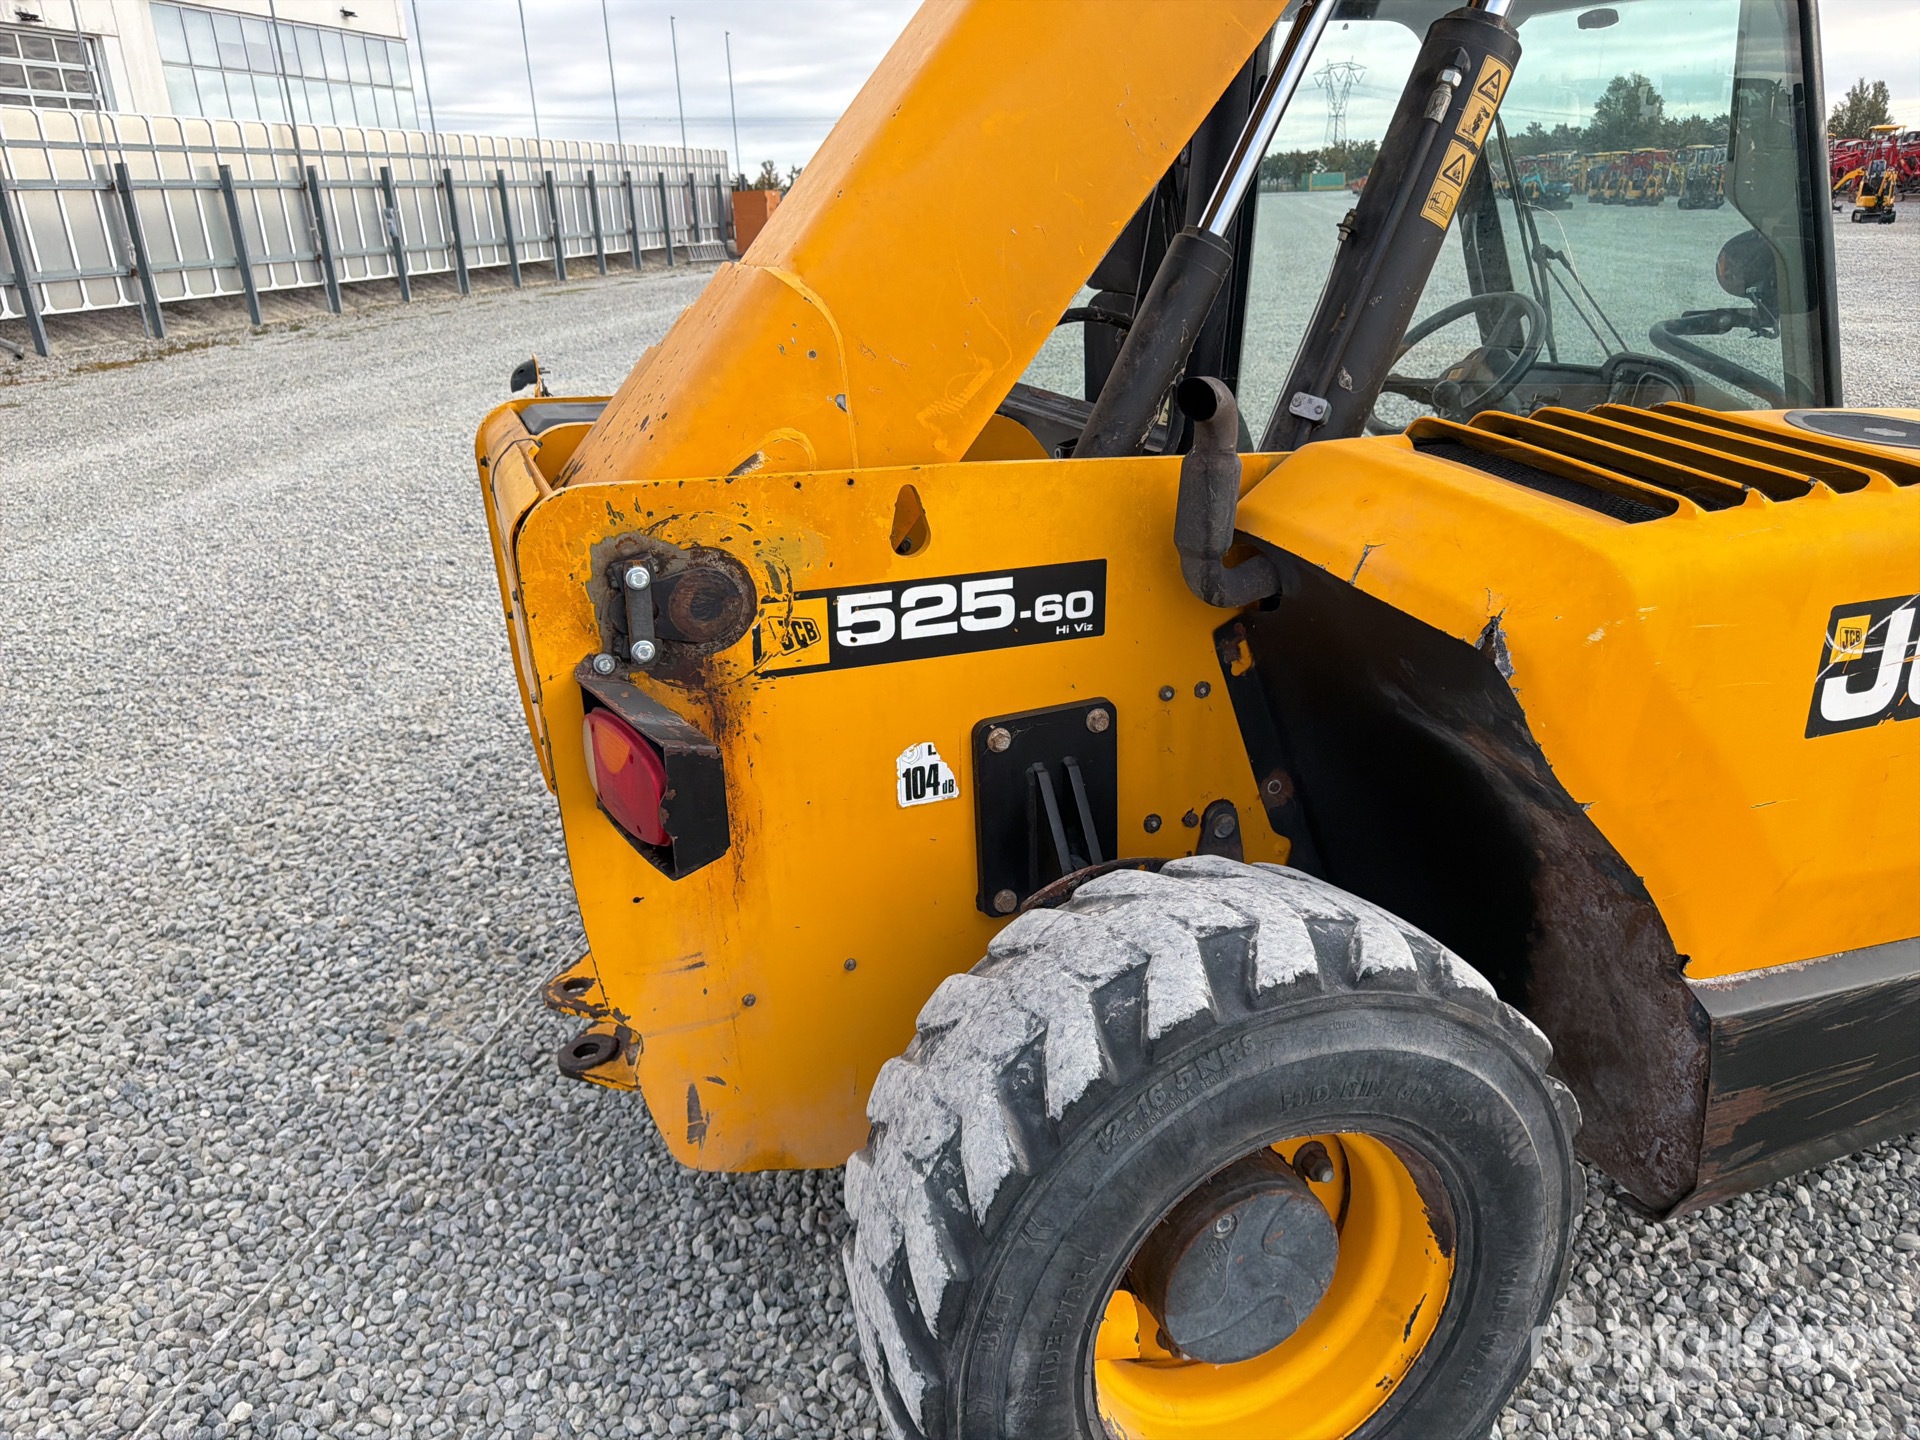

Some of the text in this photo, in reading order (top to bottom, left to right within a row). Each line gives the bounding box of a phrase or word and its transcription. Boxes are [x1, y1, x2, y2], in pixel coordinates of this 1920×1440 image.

[836, 576, 1094, 647] 525-60
[1055, 622, 1094, 635] Hi Viz
[1842, 629, 1862, 649] JCB
[902, 763, 955, 801] 104 dB
